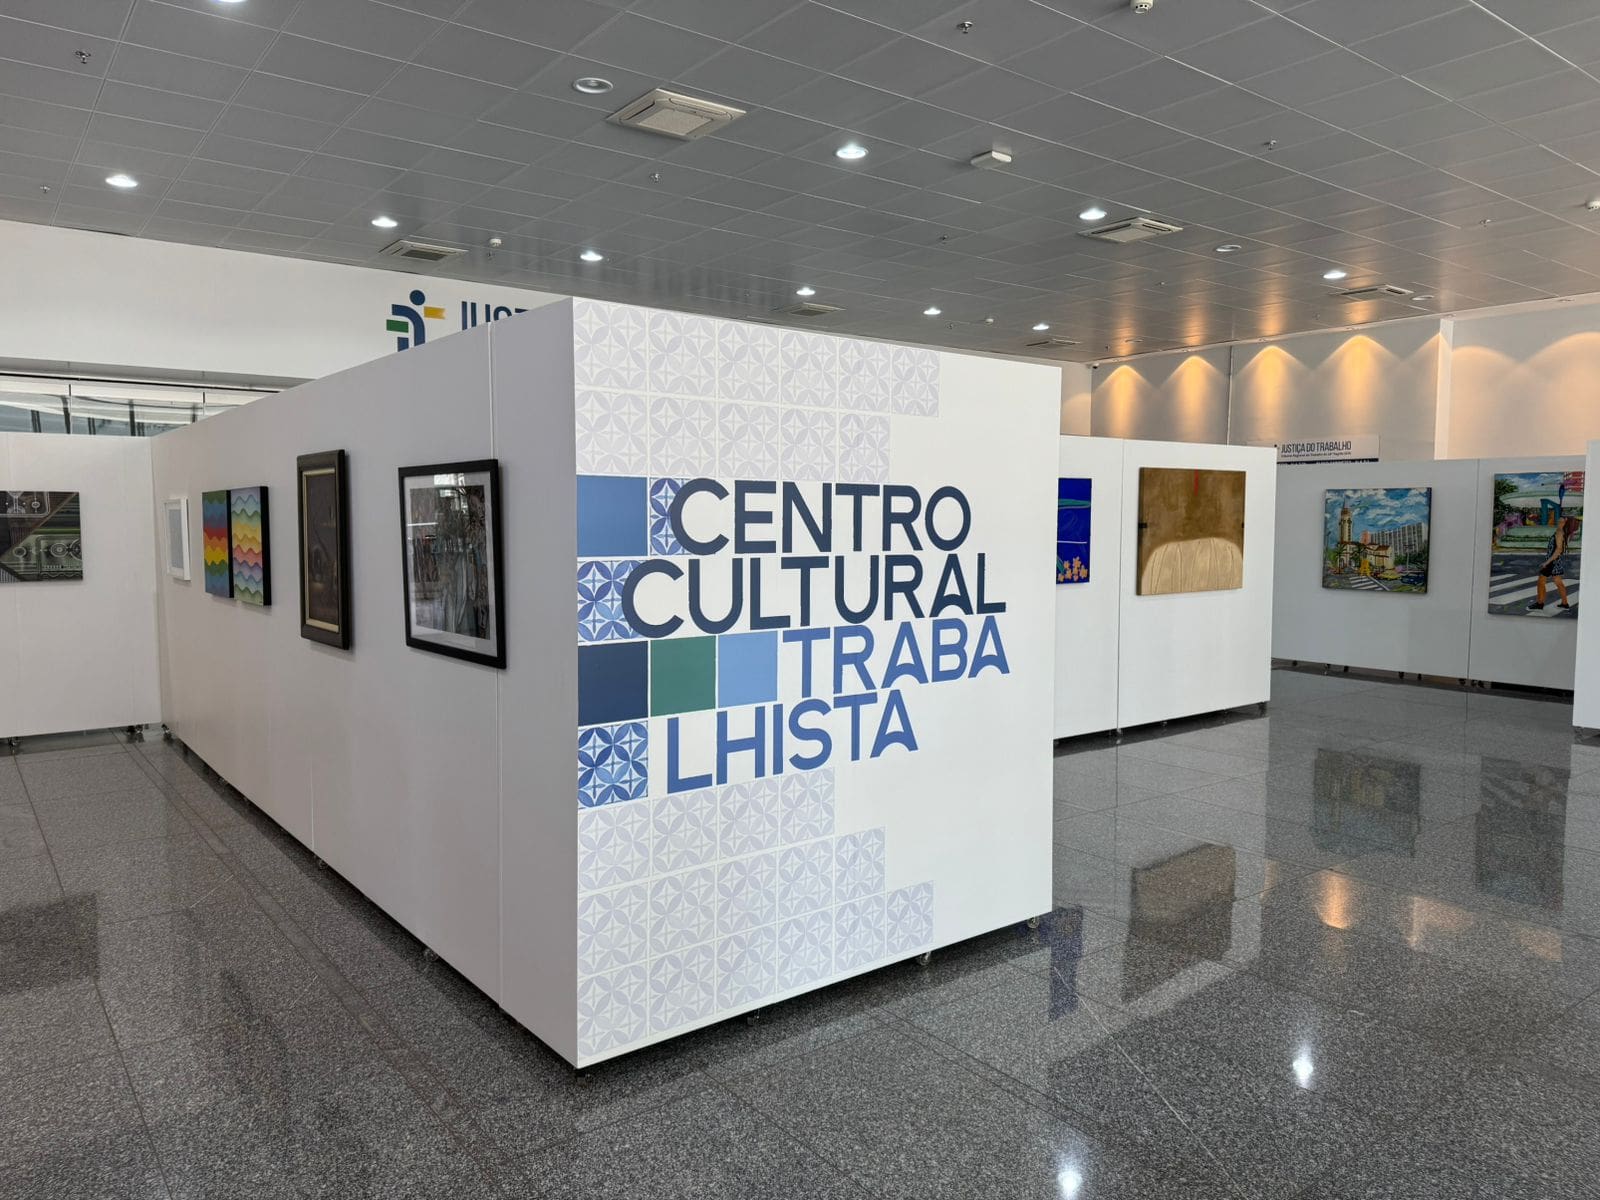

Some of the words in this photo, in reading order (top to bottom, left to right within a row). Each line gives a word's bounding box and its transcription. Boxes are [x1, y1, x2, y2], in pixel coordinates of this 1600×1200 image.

[1281, 442, 1305, 454] JUSTIÇA
[1306, 442, 1315, 453] DO
[1316, 440, 1352, 452] TRABALHO
[669, 477, 971, 556] CENTRO
[621, 552, 1007, 639] CULTURAL
[782, 615, 1010, 699] TRABA
[666, 689, 918, 795] LHISTA
